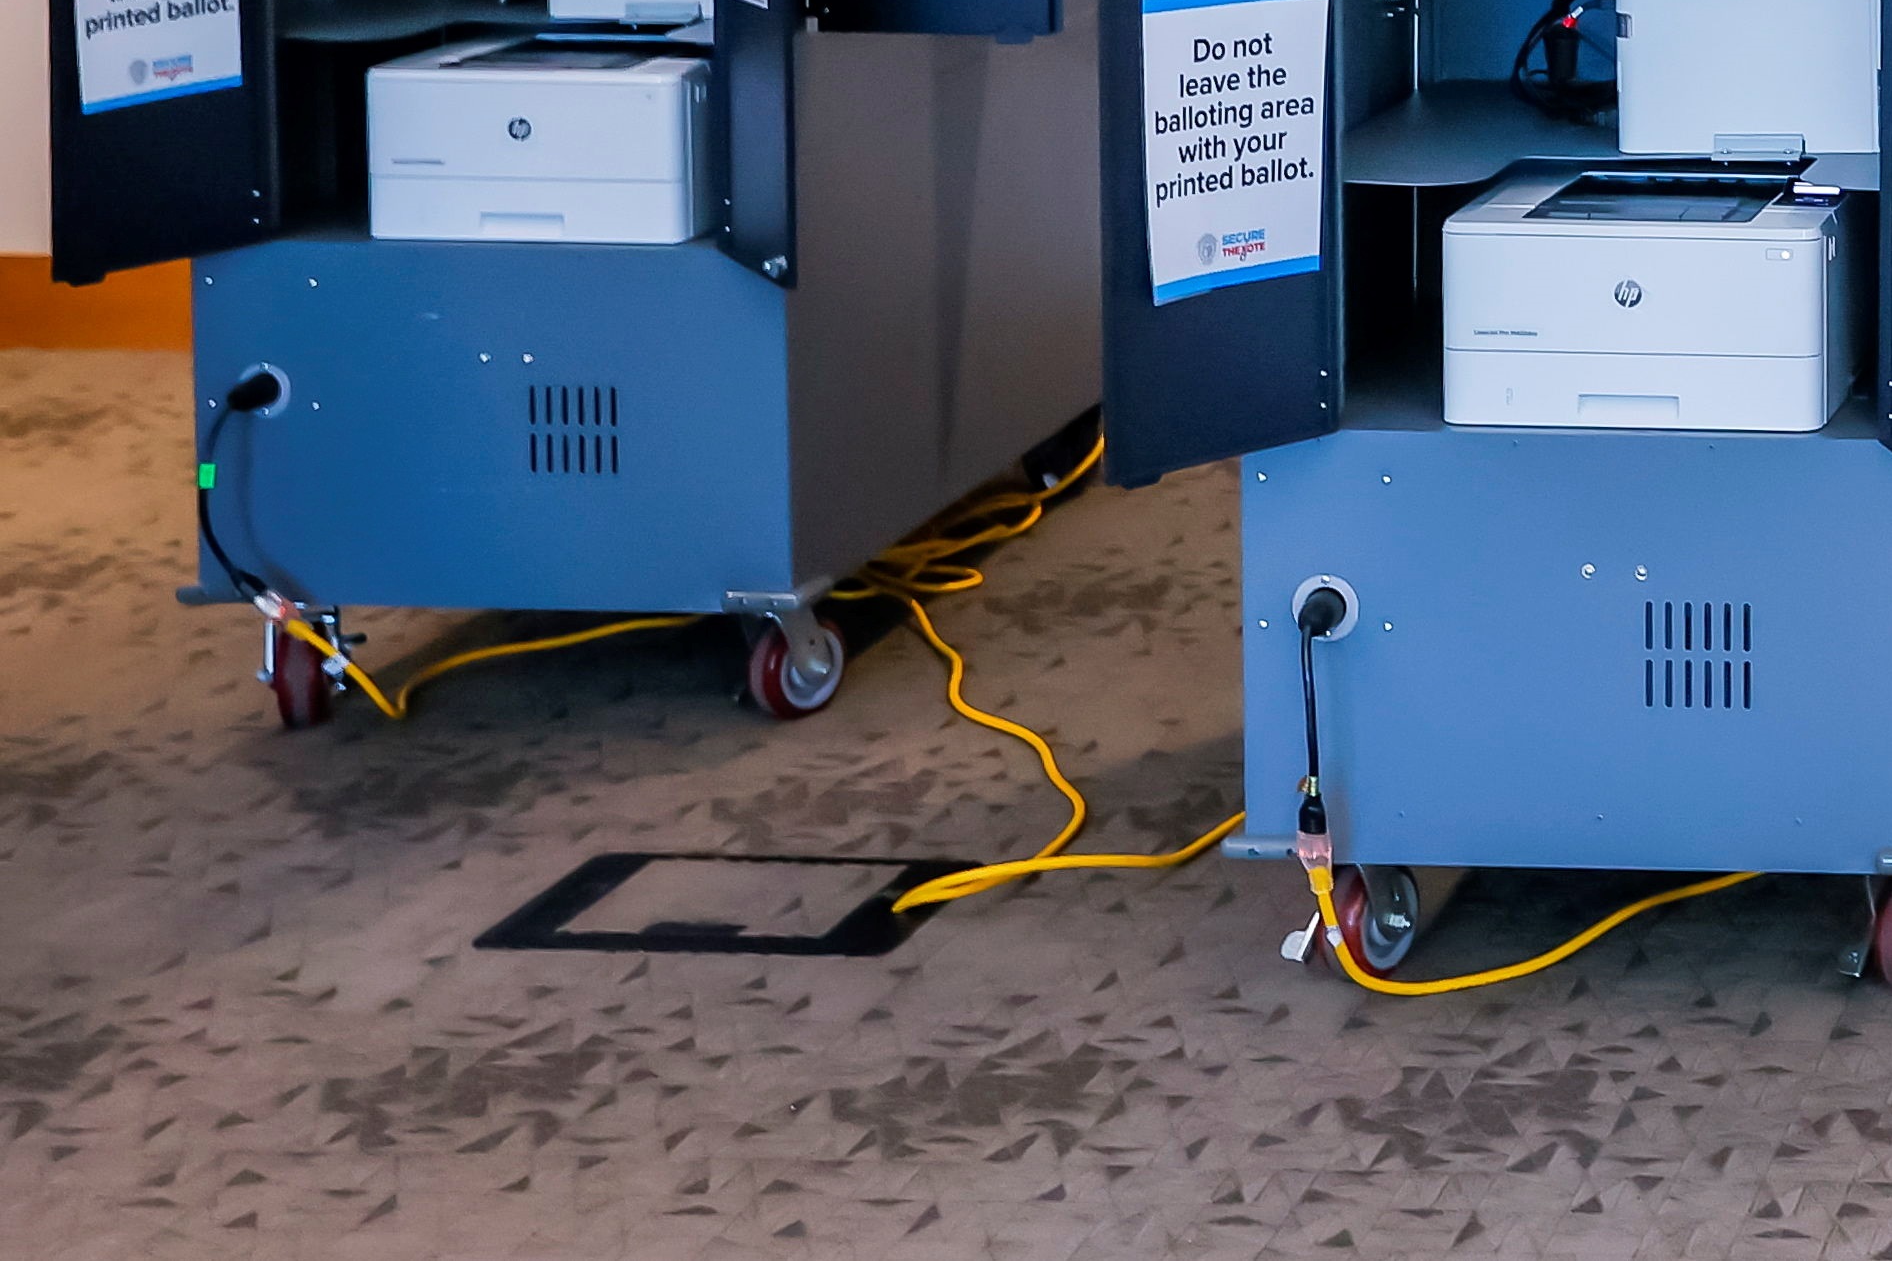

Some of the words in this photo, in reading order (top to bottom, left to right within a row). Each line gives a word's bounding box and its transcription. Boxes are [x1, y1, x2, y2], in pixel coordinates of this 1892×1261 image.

[85, 1, 161, 40] printed
[1193, 38, 1226, 63] Do
[1233, 33, 1273, 59] not
[1179, 71, 1240, 98] leave
[1247, 65, 1287, 89] the
[1155, 101, 1252, 135] balloting
[1261, 96, 1314, 120] area
[1178, 135, 1226, 163] with
[1234, 131, 1288, 162] your
[1155, 166, 1234, 209] printed
[1241, 157, 1314, 187] ballot.
[1222, 228, 1266, 245] SECURE
[1614, 279, 1643, 308] hp
